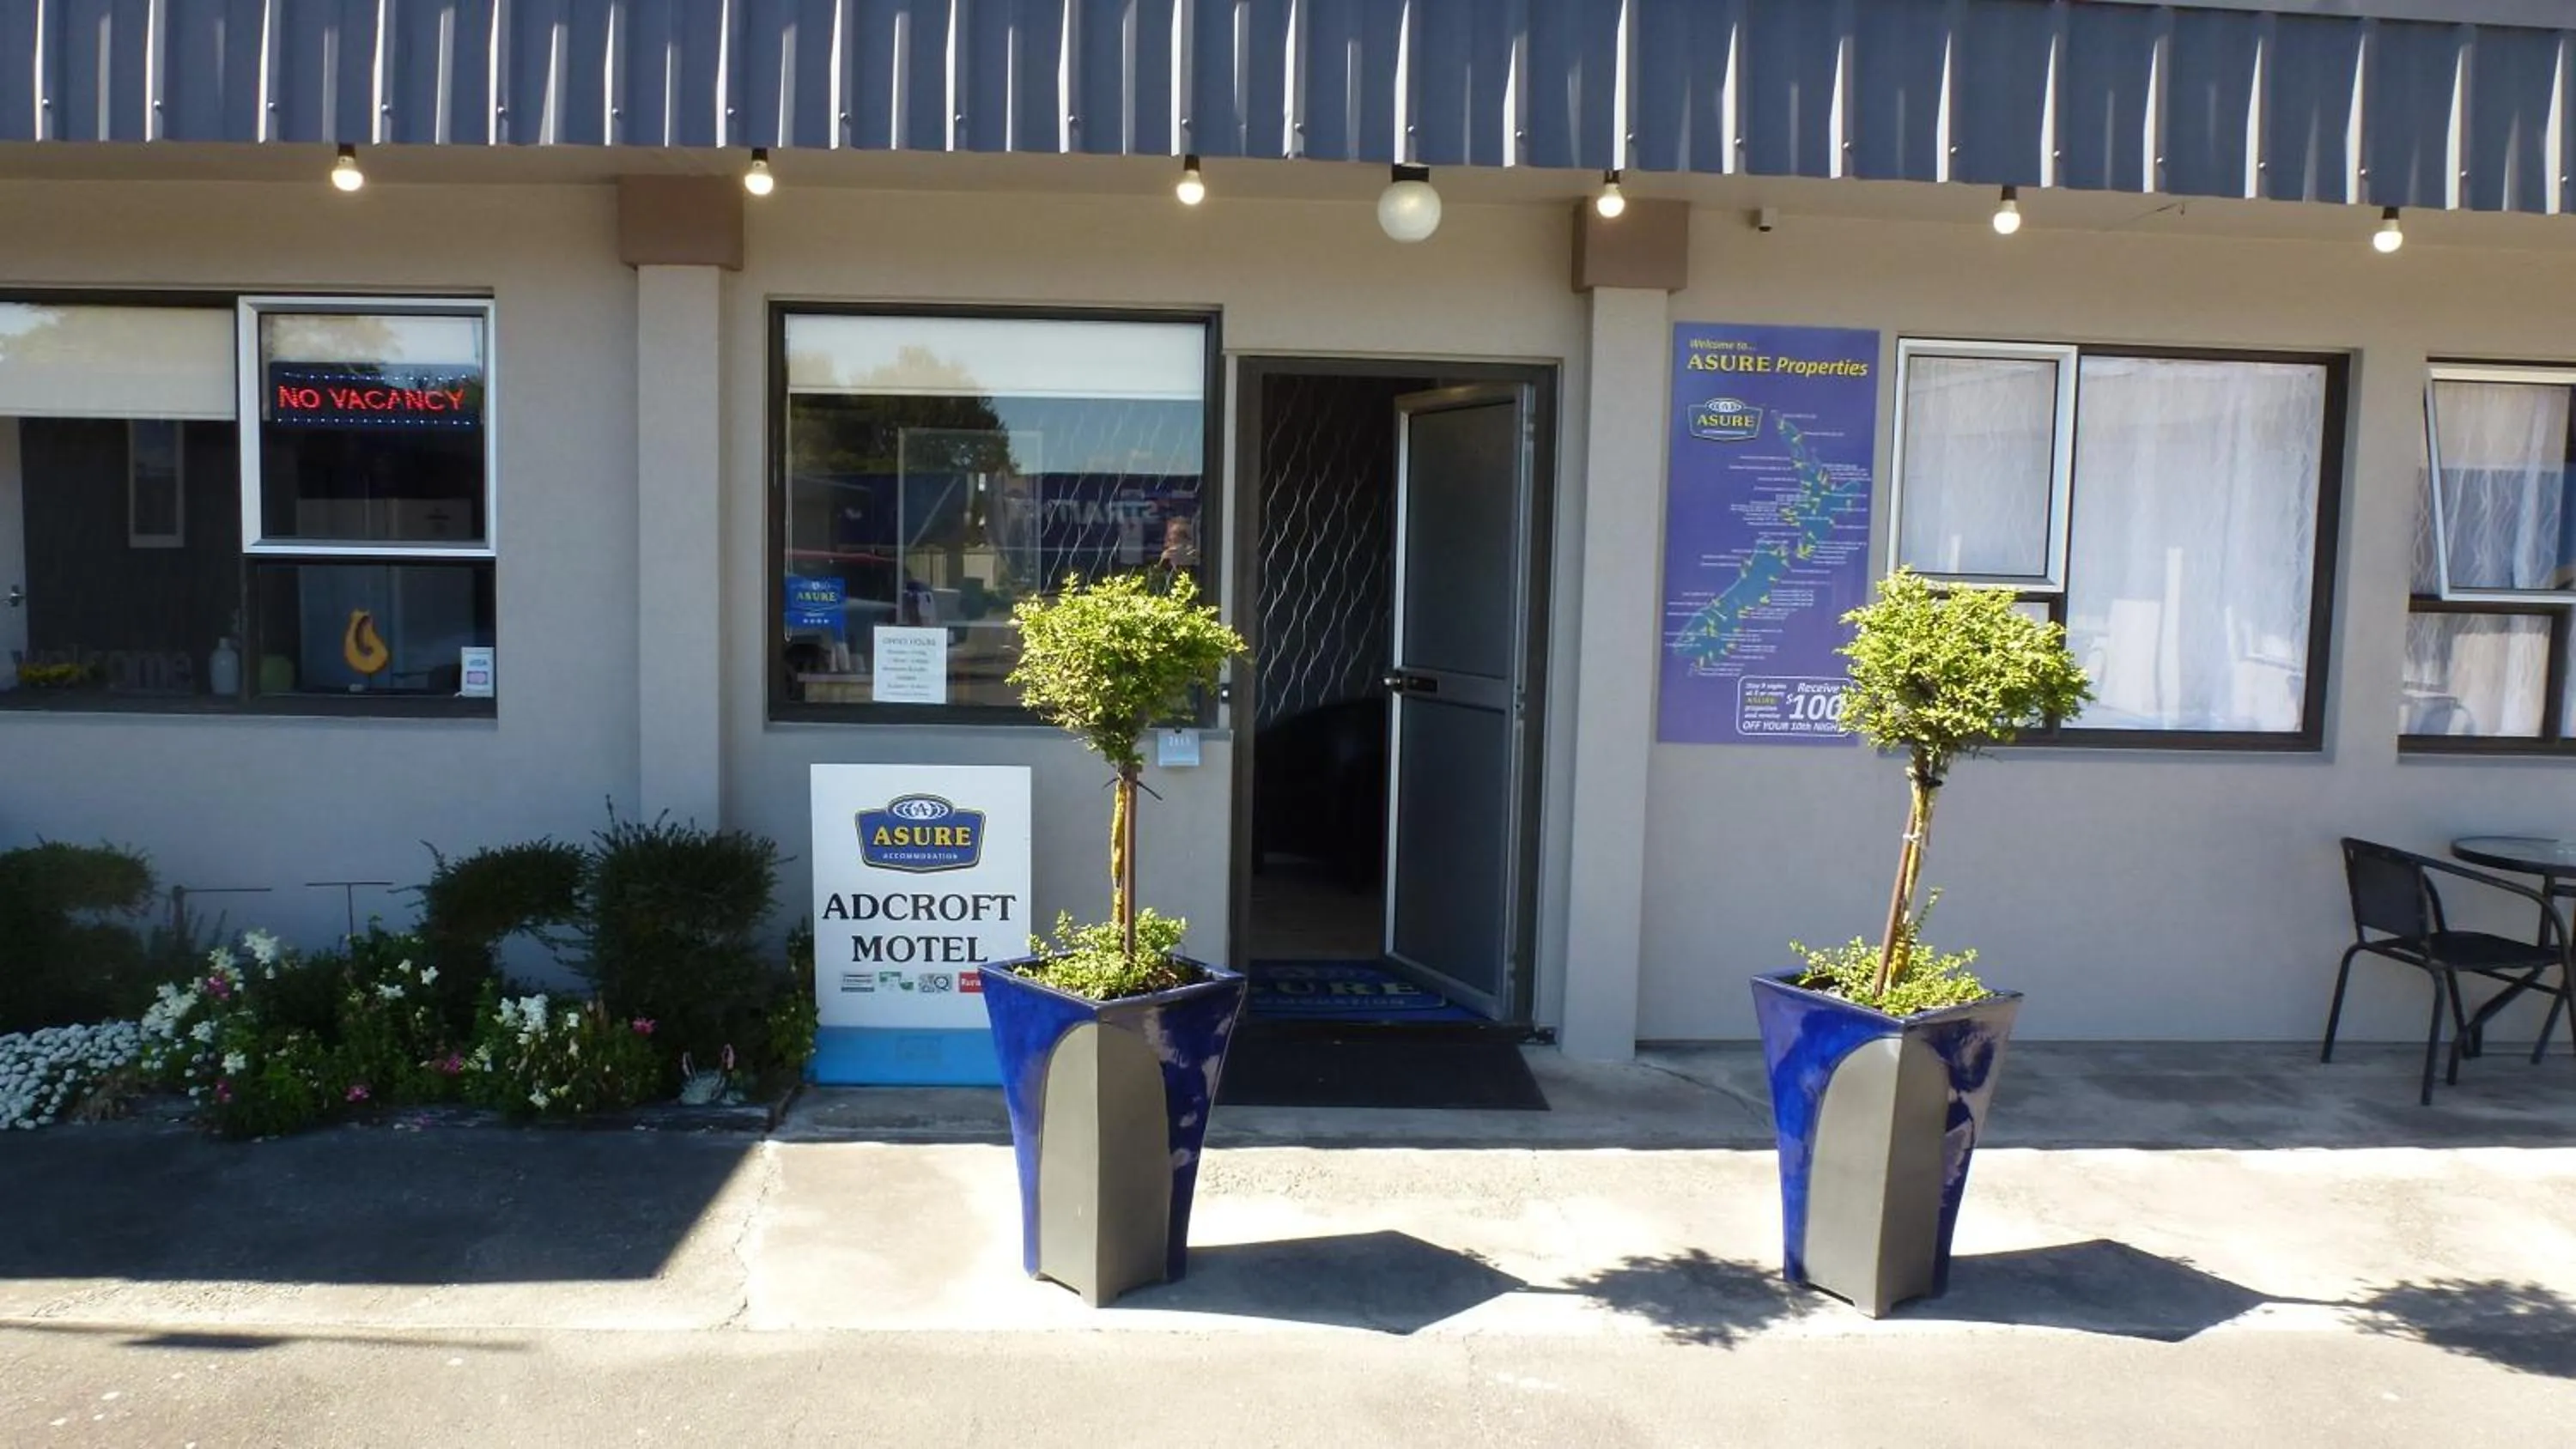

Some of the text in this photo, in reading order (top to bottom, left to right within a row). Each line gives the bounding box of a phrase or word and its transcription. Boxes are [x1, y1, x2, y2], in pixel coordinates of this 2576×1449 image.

[1689, 337, 1735, 350] Welcome
[1686, 353, 1869, 377] ASURE Properties
[277, 385, 466, 411] NO VACANCY
[1697, 414, 1755, 427] ASURE
[1797, 682, 1840, 694] Receive
[1742, 721, 1762, 730] OFF
[1763, 722, 1789, 731] YOUR
[1791, 722, 1812, 731] 10th
[873, 826, 972, 846] ASURE
[822, 893, 1017, 922] ADCROFT
[851, 935, 989, 963] MOTEL
[1250, 981, 1422, 995] URE
